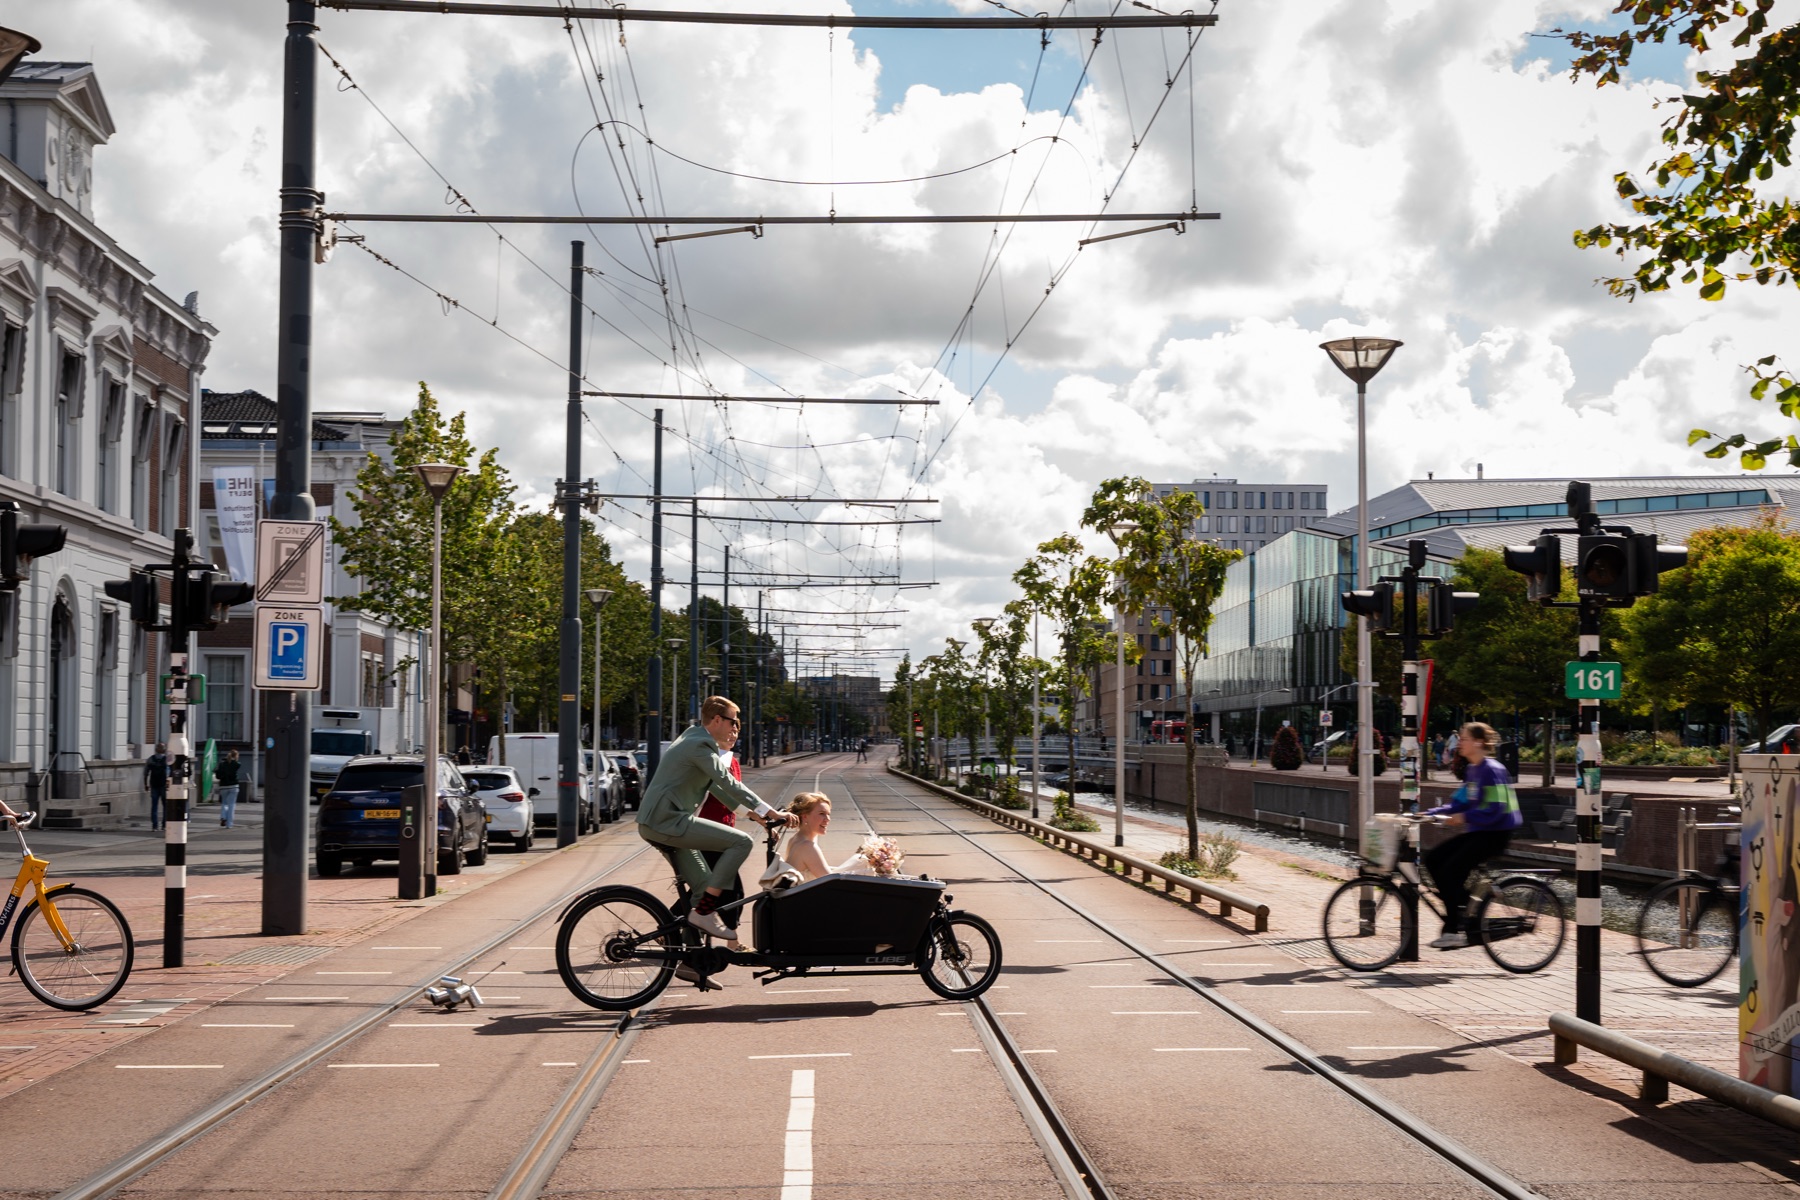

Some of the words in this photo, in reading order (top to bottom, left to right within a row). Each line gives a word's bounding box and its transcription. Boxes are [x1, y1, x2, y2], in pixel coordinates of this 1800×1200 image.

[277, 526, 306, 535] ZONE
[275, 612, 304, 620] ZONE
[277, 628, 299, 656] P
[1574, 669, 1615, 690] 161
[865, 956, 907, 964] CUBE
